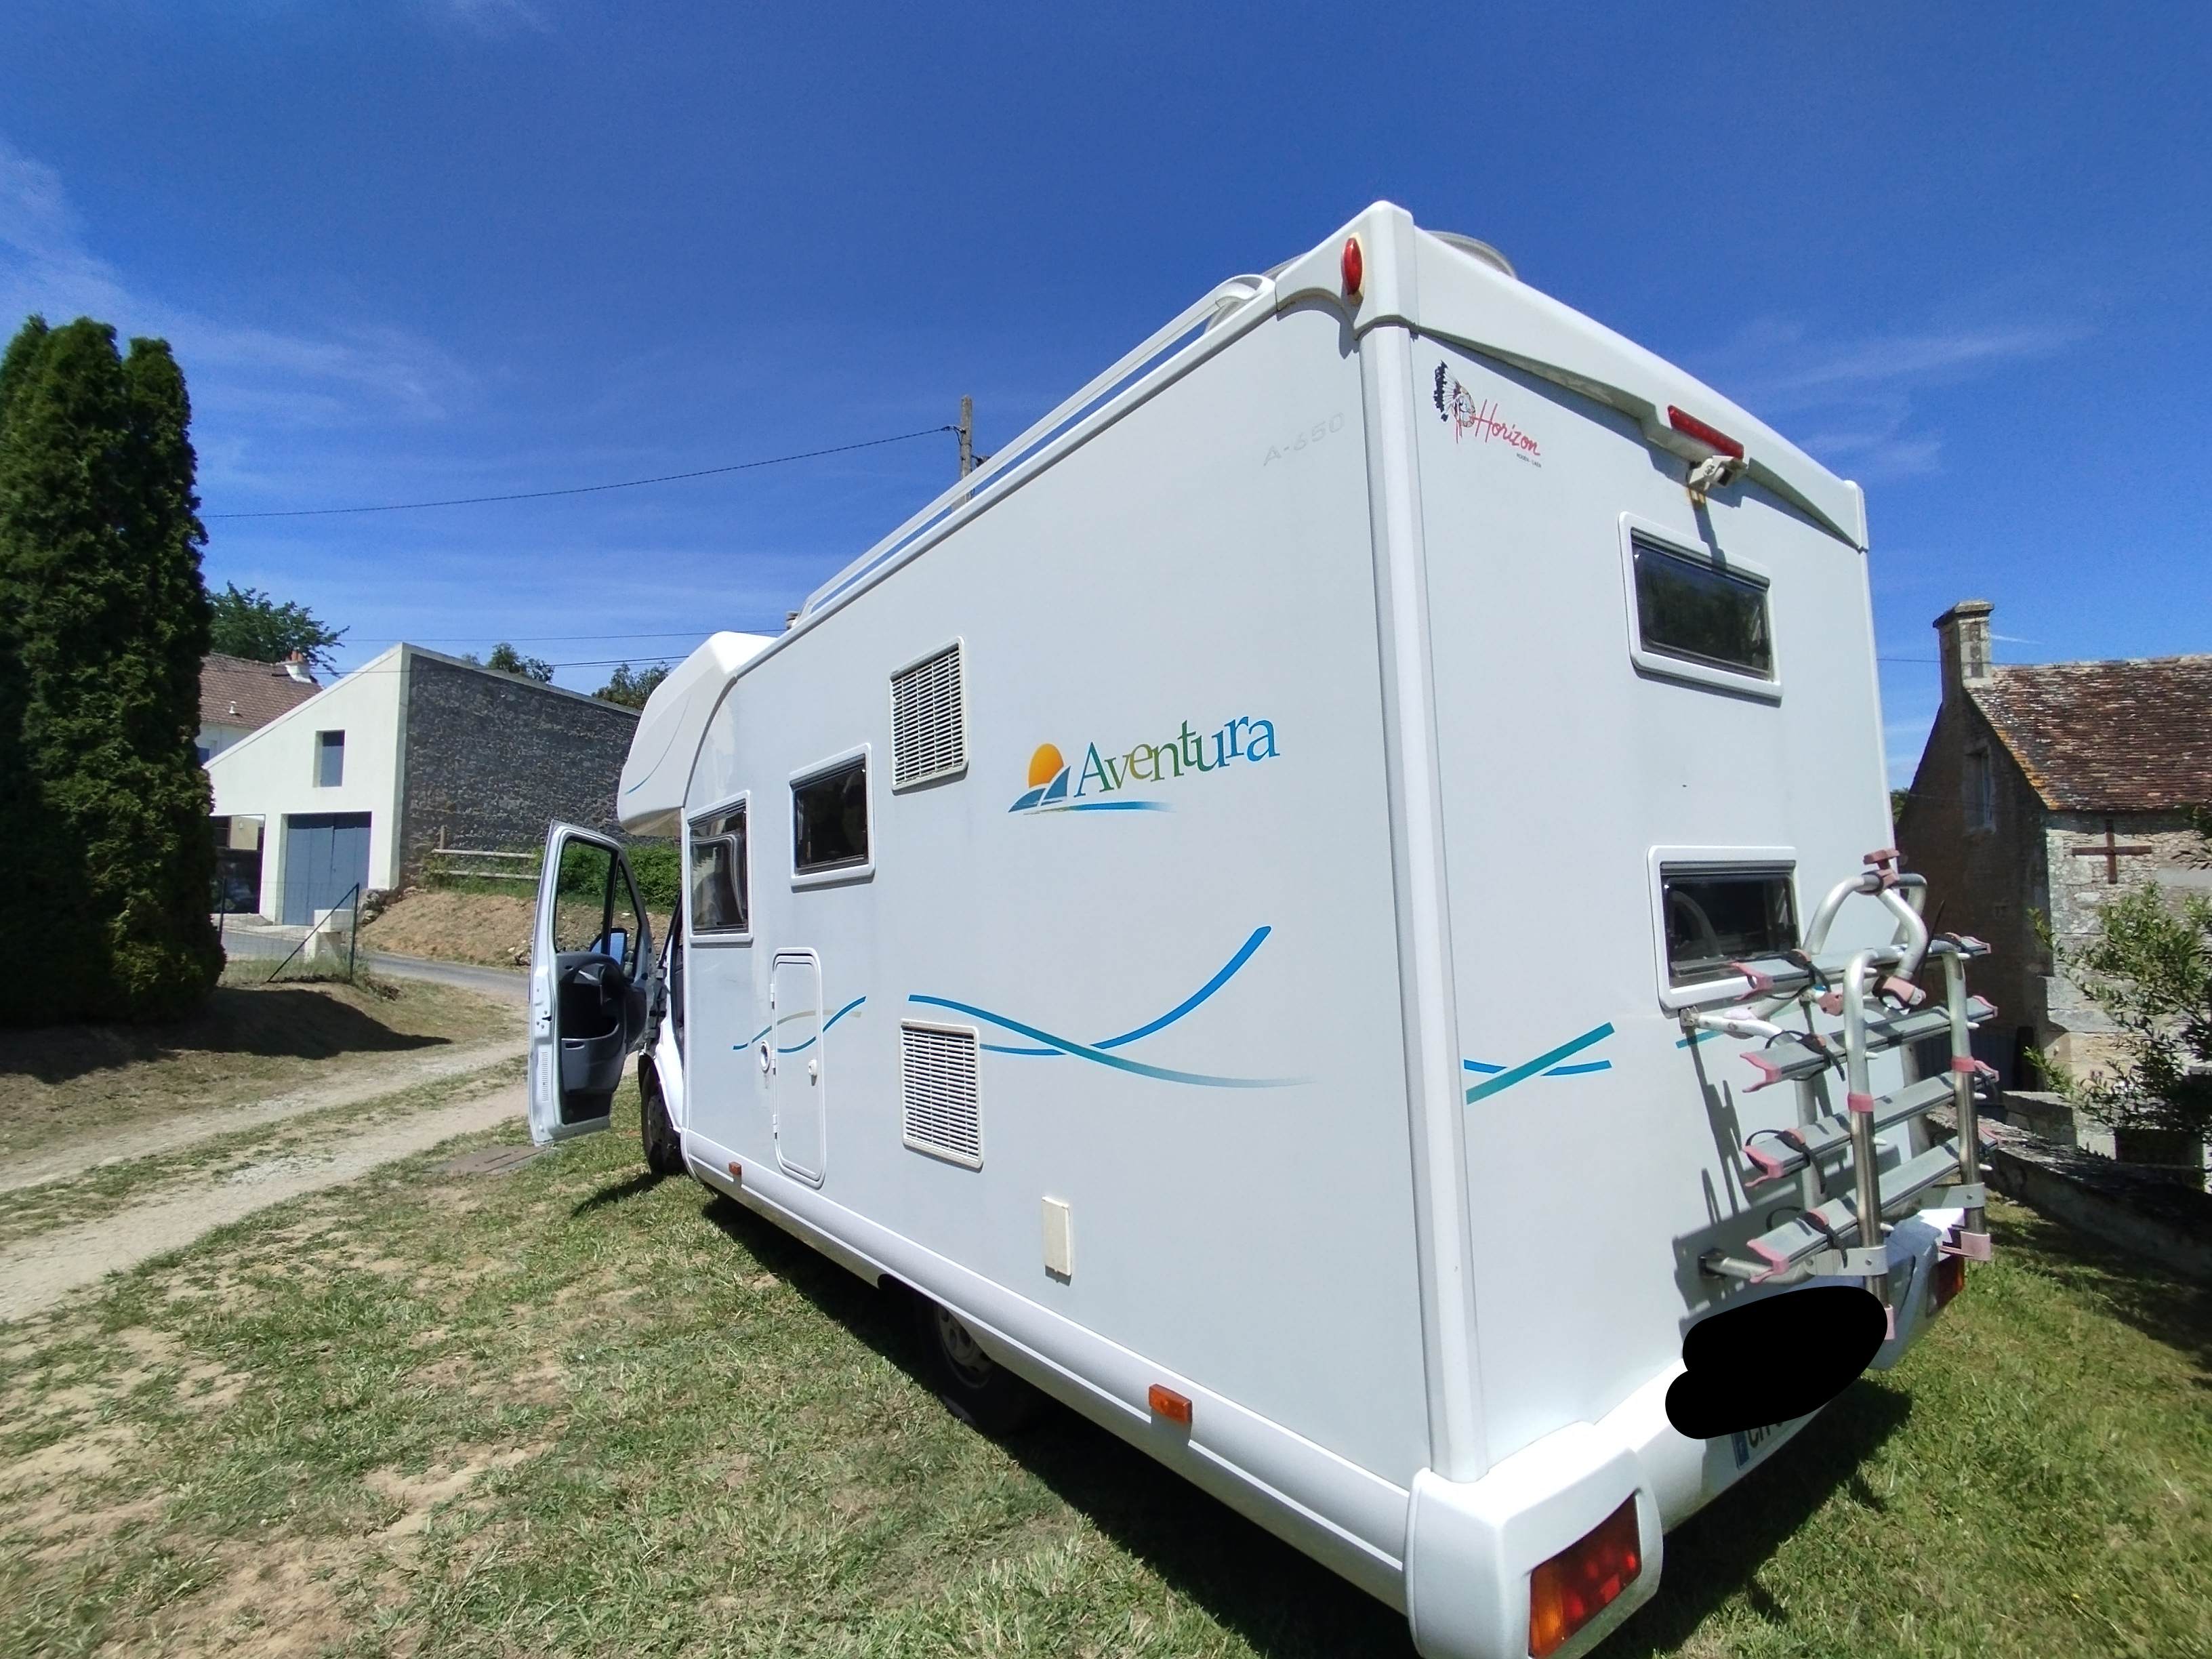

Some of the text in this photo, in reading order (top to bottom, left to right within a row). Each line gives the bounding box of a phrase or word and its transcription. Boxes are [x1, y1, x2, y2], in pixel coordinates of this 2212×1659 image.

[1263, 412, 1345, 466] A-650
[1469, 398, 1540, 456] Horizon
[1074, 716, 1280, 798] Aventura
